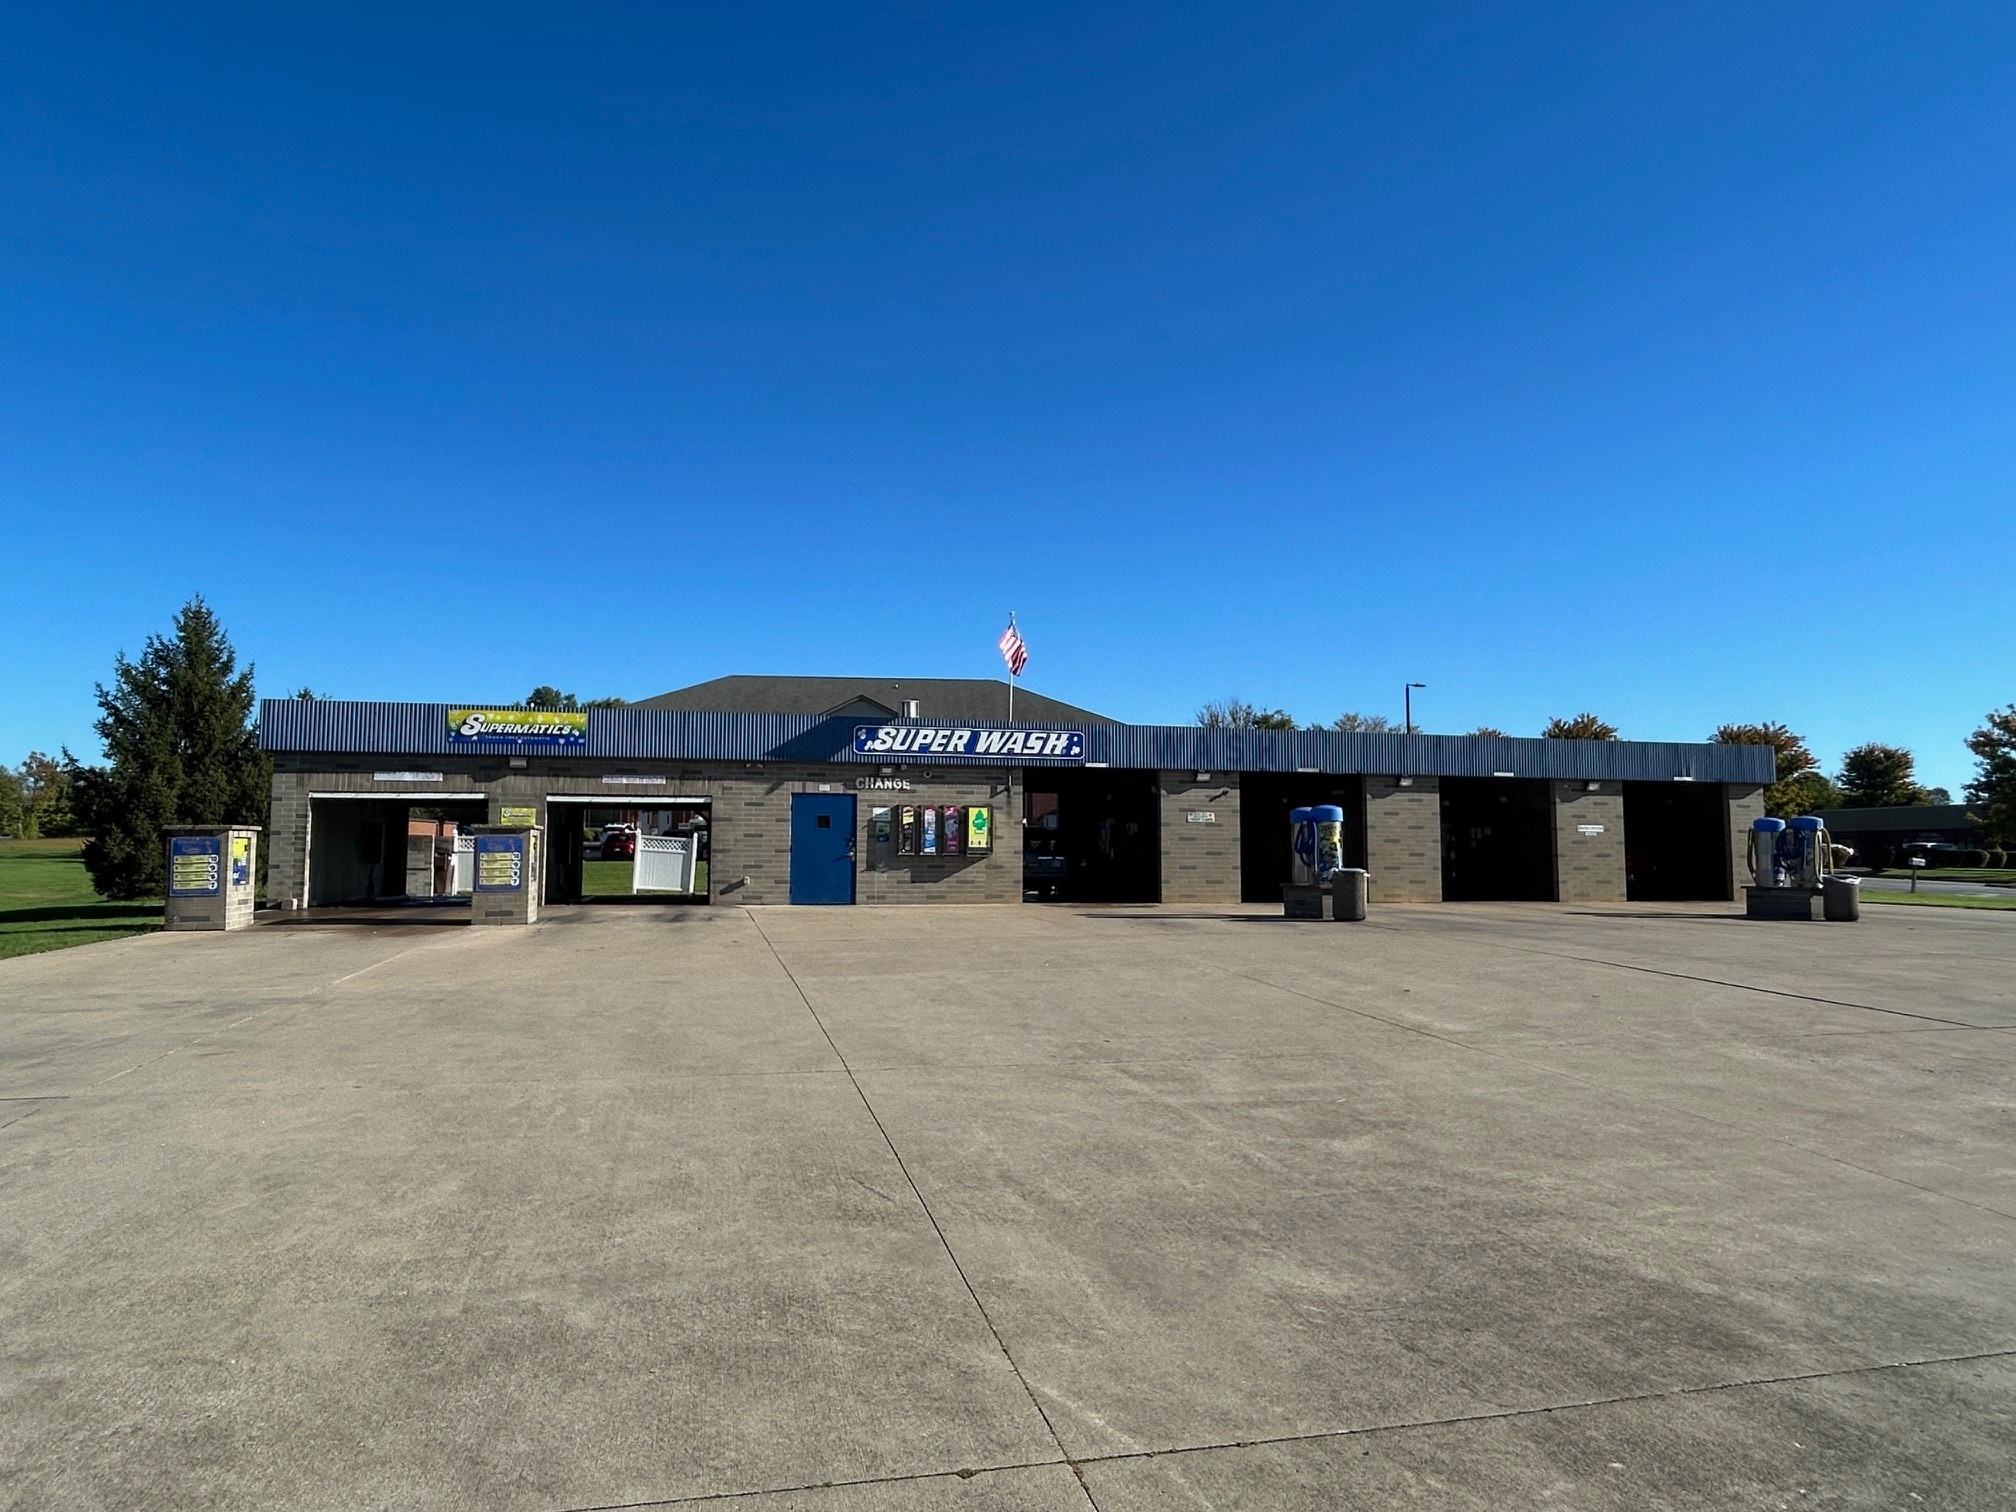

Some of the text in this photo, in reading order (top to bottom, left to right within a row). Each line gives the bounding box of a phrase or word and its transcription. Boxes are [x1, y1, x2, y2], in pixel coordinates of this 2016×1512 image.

[460, 713, 573, 736] SUPERMATICS
[873, 728, 1070, 755] SUPER WASH
[855, 777, 911, 790] CHANGE
